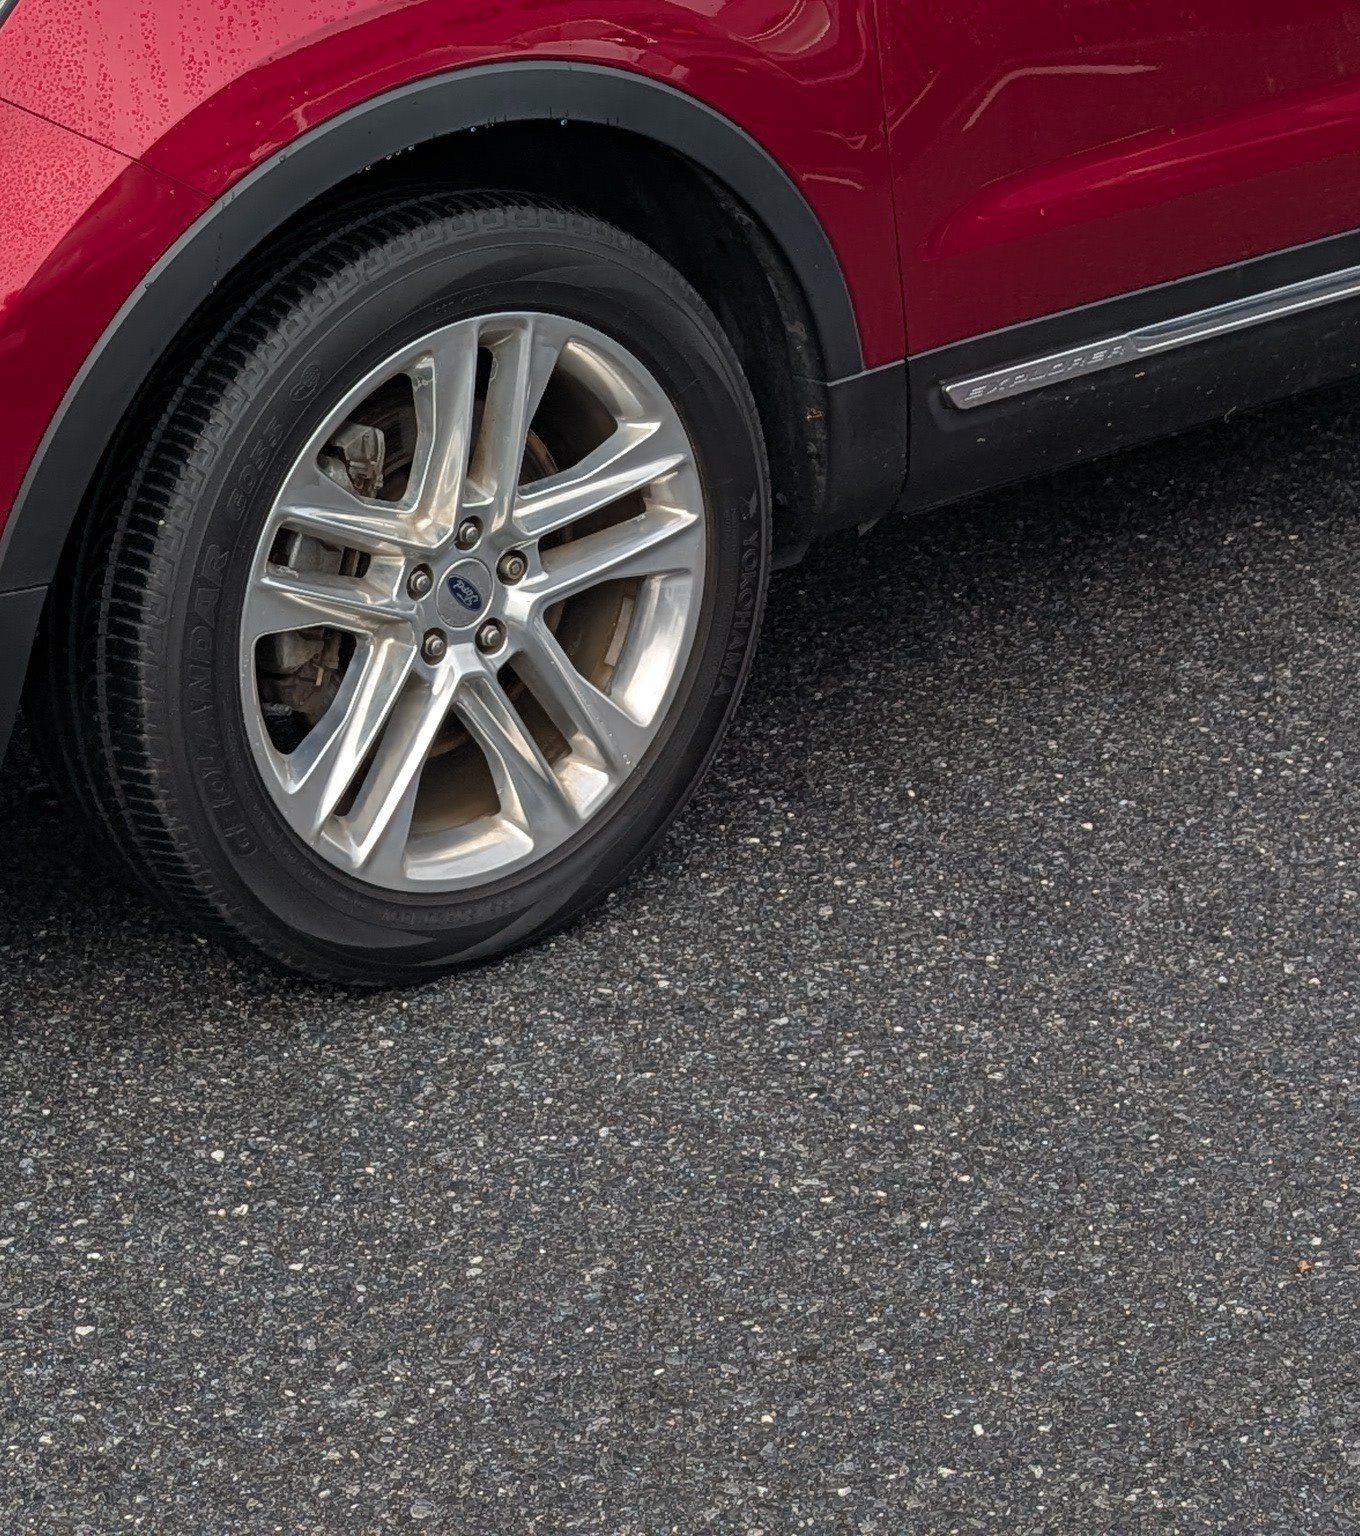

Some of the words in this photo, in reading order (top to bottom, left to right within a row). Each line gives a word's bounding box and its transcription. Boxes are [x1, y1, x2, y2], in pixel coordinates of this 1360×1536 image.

[964, 344, 1126, 402] EXPLORER
[452, 579, 479, 607] Ford
[713, 529, 760, 697] YOKOHAMA
